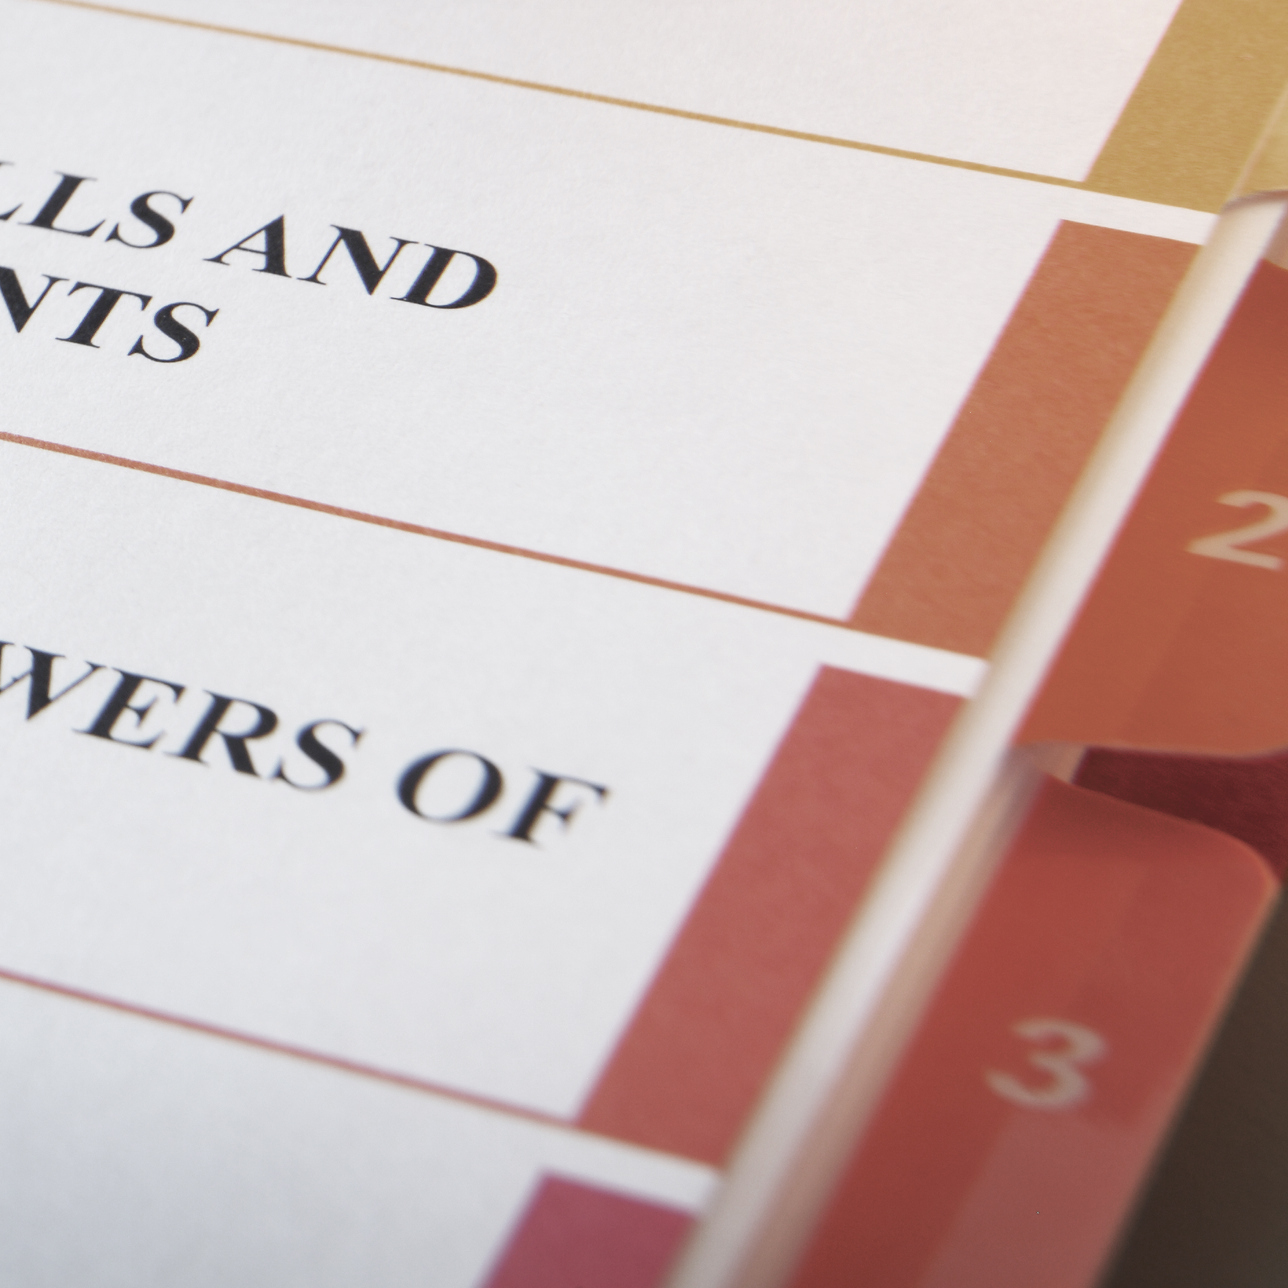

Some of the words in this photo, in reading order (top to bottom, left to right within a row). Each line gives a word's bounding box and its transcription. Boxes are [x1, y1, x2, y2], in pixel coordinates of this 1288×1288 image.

[202, 213, 499, 311] AND
[1187, 489, 1288, 570] 2
[395, 745, 612, 849] OF
[984, 1017, 1108, 1108] 3
